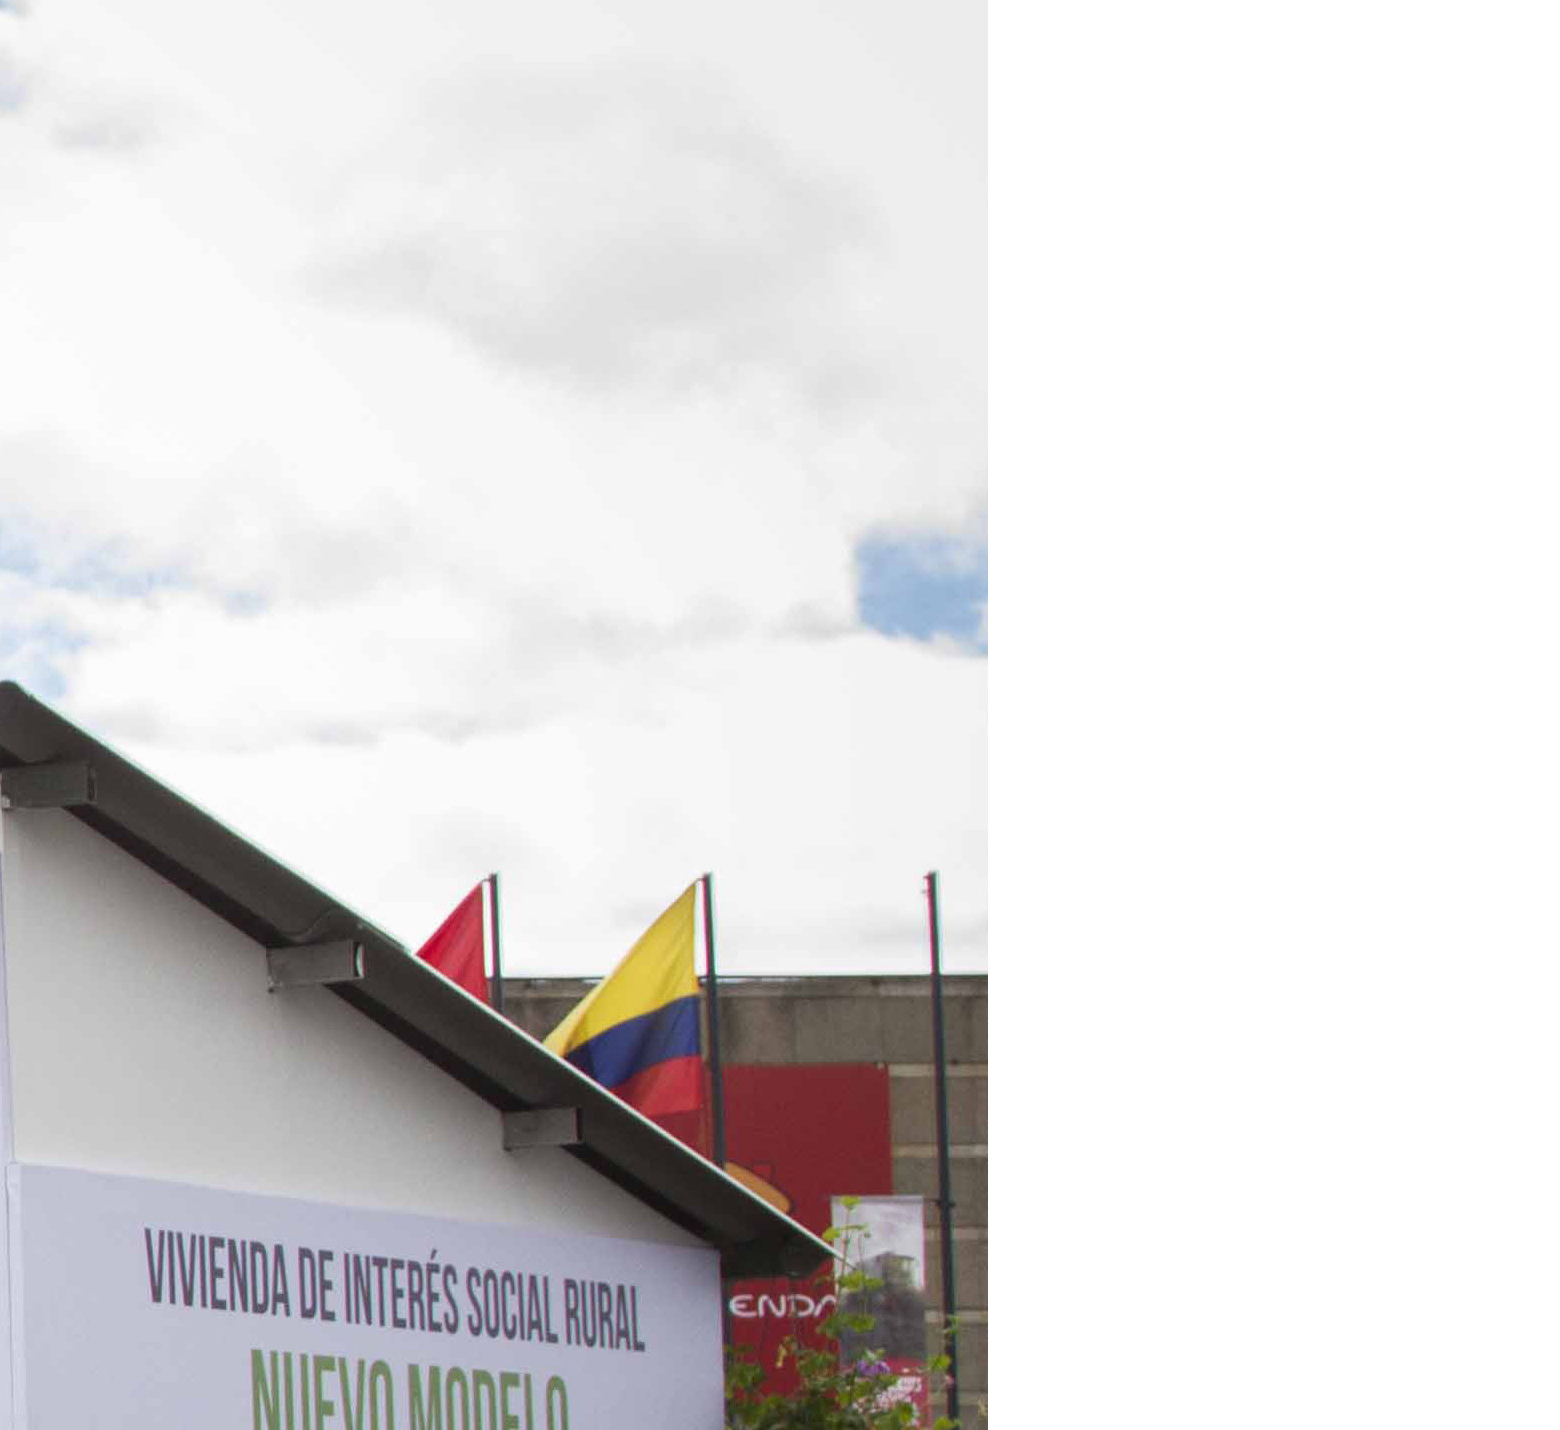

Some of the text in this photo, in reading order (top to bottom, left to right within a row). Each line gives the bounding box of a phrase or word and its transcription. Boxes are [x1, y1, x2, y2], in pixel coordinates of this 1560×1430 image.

[144, 1227, 646, 1352] VIVIENDA DE INTERÉS SOCIAL RURAL
